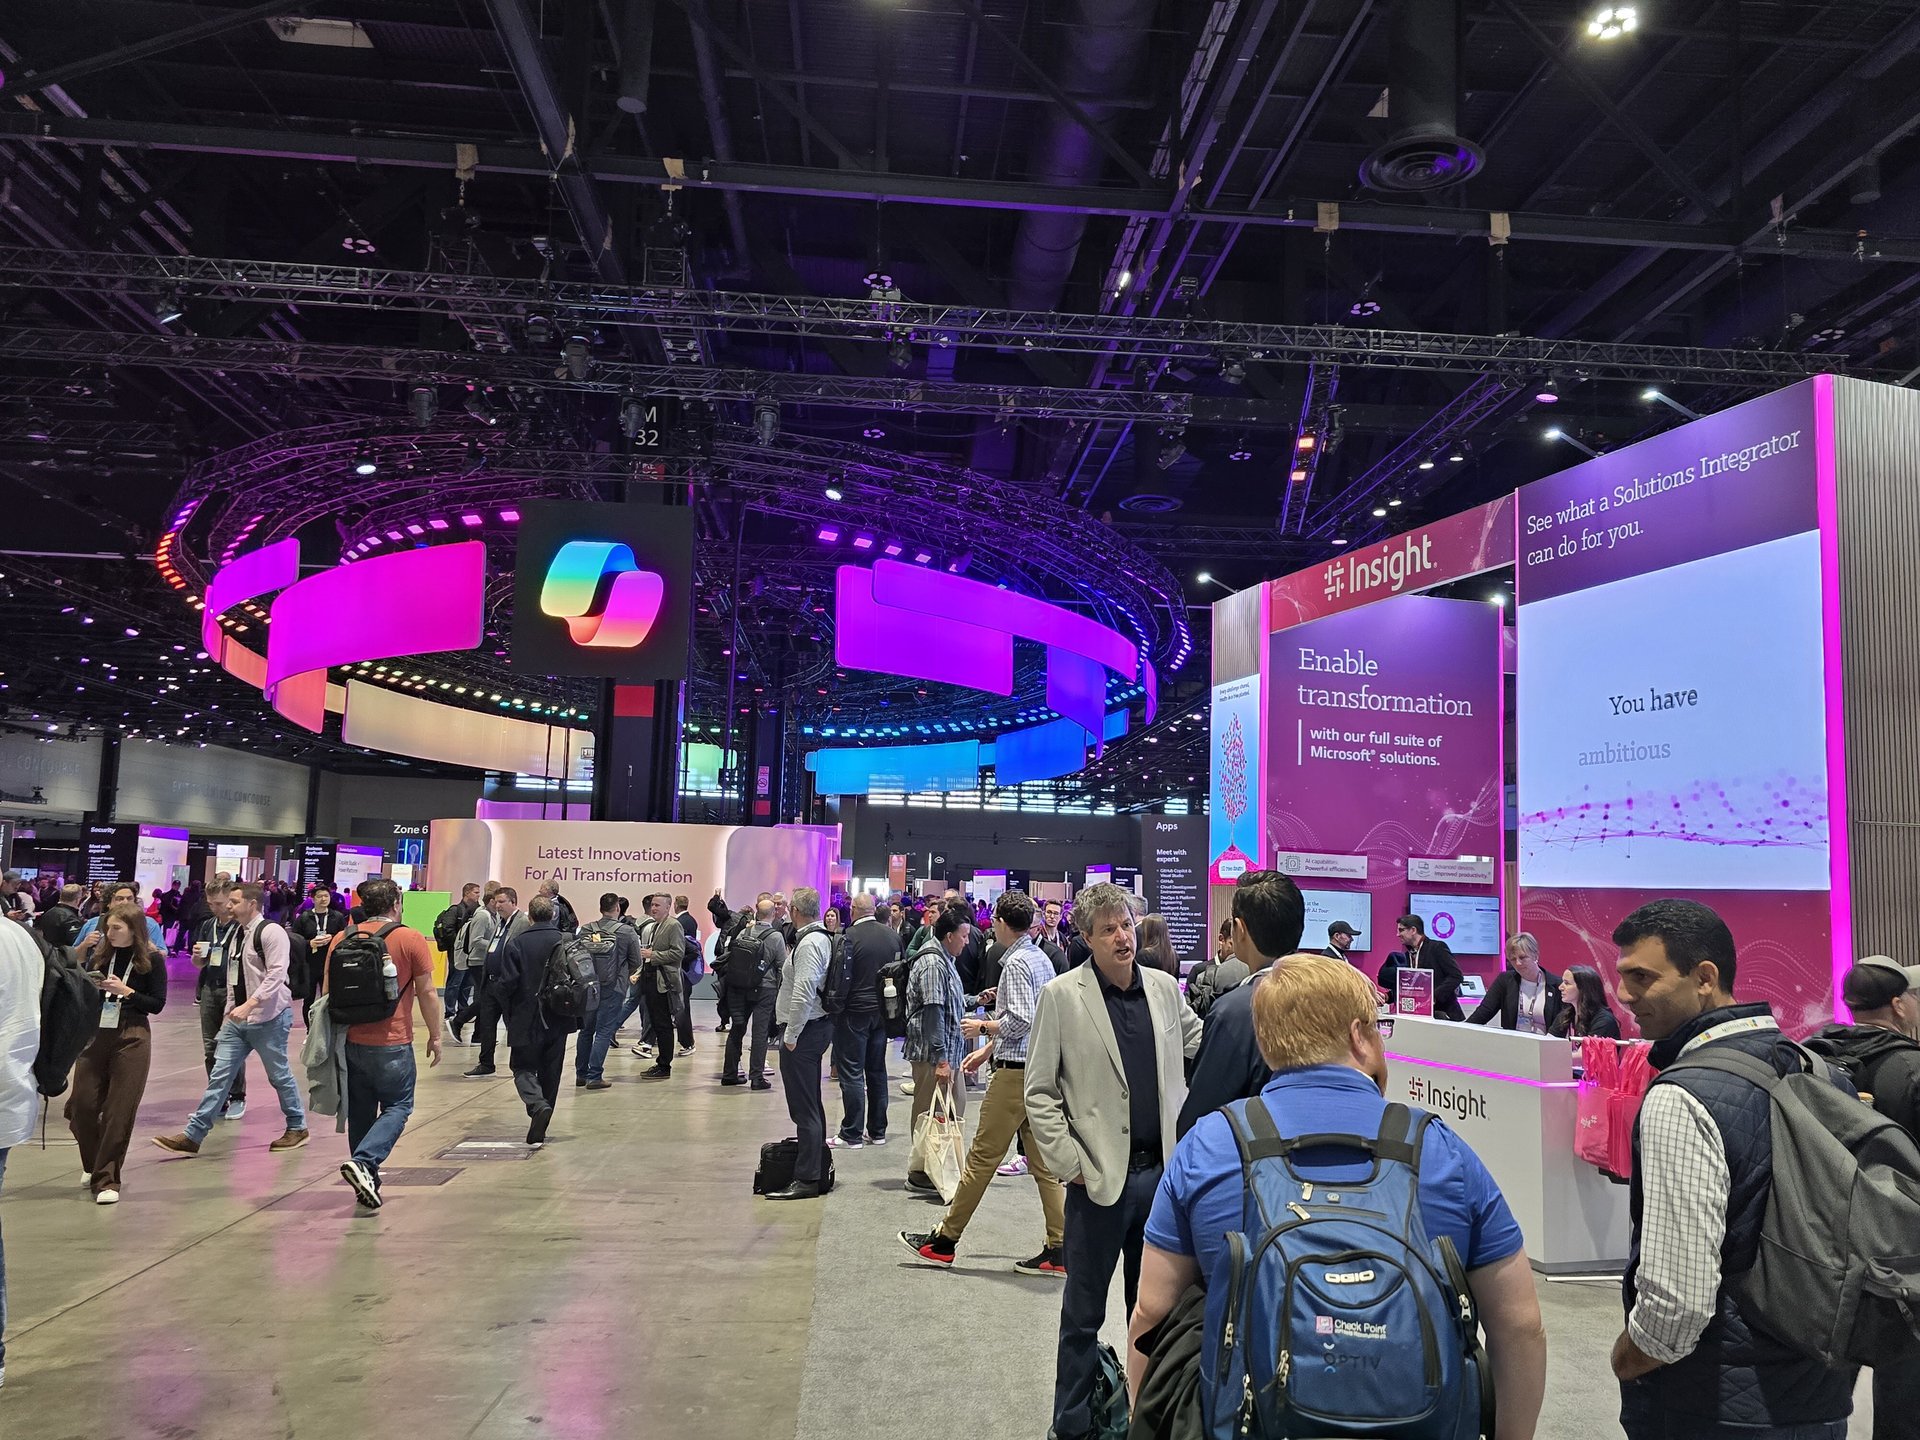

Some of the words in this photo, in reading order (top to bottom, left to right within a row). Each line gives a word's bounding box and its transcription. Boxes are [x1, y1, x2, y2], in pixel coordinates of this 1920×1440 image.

[635, 429, 659, 446] 32
[1527, 513, 1553, 535] See
[1556, 497, 1596, 525] what
[1599, 495, 1610, 512] a
[1613, 464, 1696, 508] Solutions
[1699, 428, 1801, 480] Integrator
[1527, 546, 1554, 567] can
[1558, 532, 1578, 557] do
[1580, 527, 1604, 552] for
[1608, 519, 1645, 549] you.
[1298, 647, 1379, 677] Enable
[1298, 683, 1474, 717] transformation
[1608, 695, 1645, 716] You
[1649, 687, 1699, 712] have
[1310, 727, 1340, 742] with
[1343, 731, 1366, 744] our
[1369, 730, 1391, 746] full
[1394, 732, 1425, 747] suite
[1427, 734, 1443, 748] of
[1379, 750, 1441, 767] solutions.
[1577, 740, 1672, 767] ambitious
[90, 826, 117, 835] Security
[393, 824, 420, 834] Zone
[422, 825, 429, 834] 6
[1156, 822, 1178, 832] Apps
[537, 845, 584, 861] Latest
[589, 845, 681, 863] Innovations
[525, 867, 549, 881] For
[552, 867, 568, 881] AI
[572, 866, 693, 883] Transformation
[1324, 1269, 1375, 1284] OGIO
[1334, 1318, 1362, 1332] Check
[1363, 1322, 1387, 1334] Point
[1323, 1351, 1381, 1371] OPTIV
